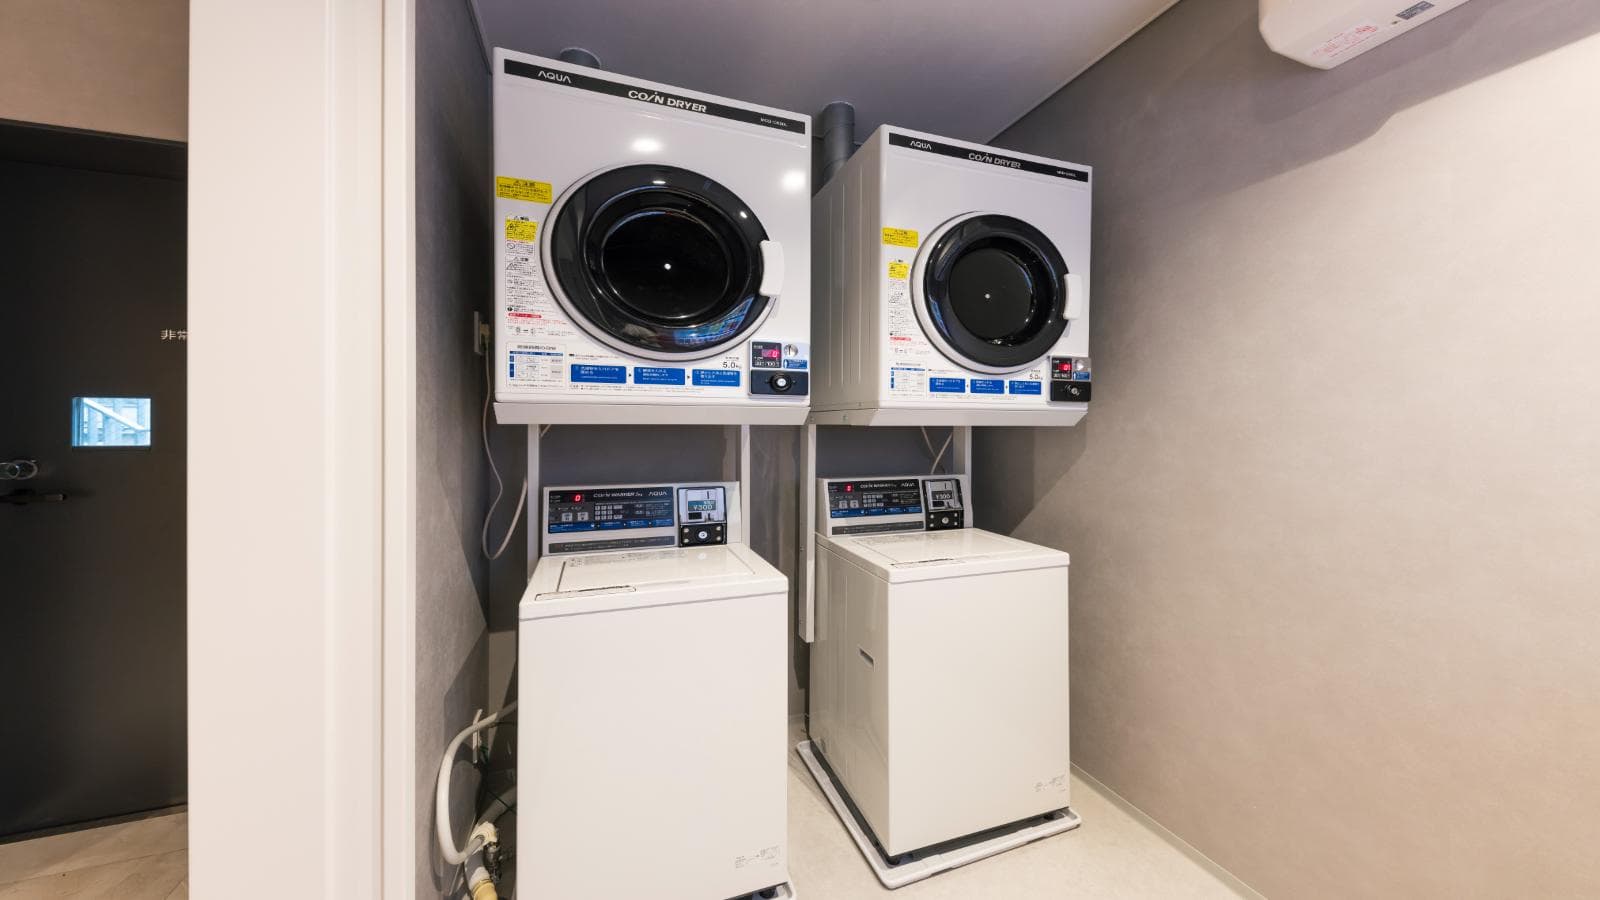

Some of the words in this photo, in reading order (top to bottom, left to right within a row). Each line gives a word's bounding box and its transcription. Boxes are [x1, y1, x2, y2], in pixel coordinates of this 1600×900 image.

[537, 70, 571, 84] AQUA
[628, 89, 665, 105] COIN
[666, 98, 708, 113] DRYER
[910, 140, 932, 150] AQUA
[968, 152, 993, 165] COIN
[994, 158, 1021, 169] DRYER
[648, 490, 668, 498] AQUA
